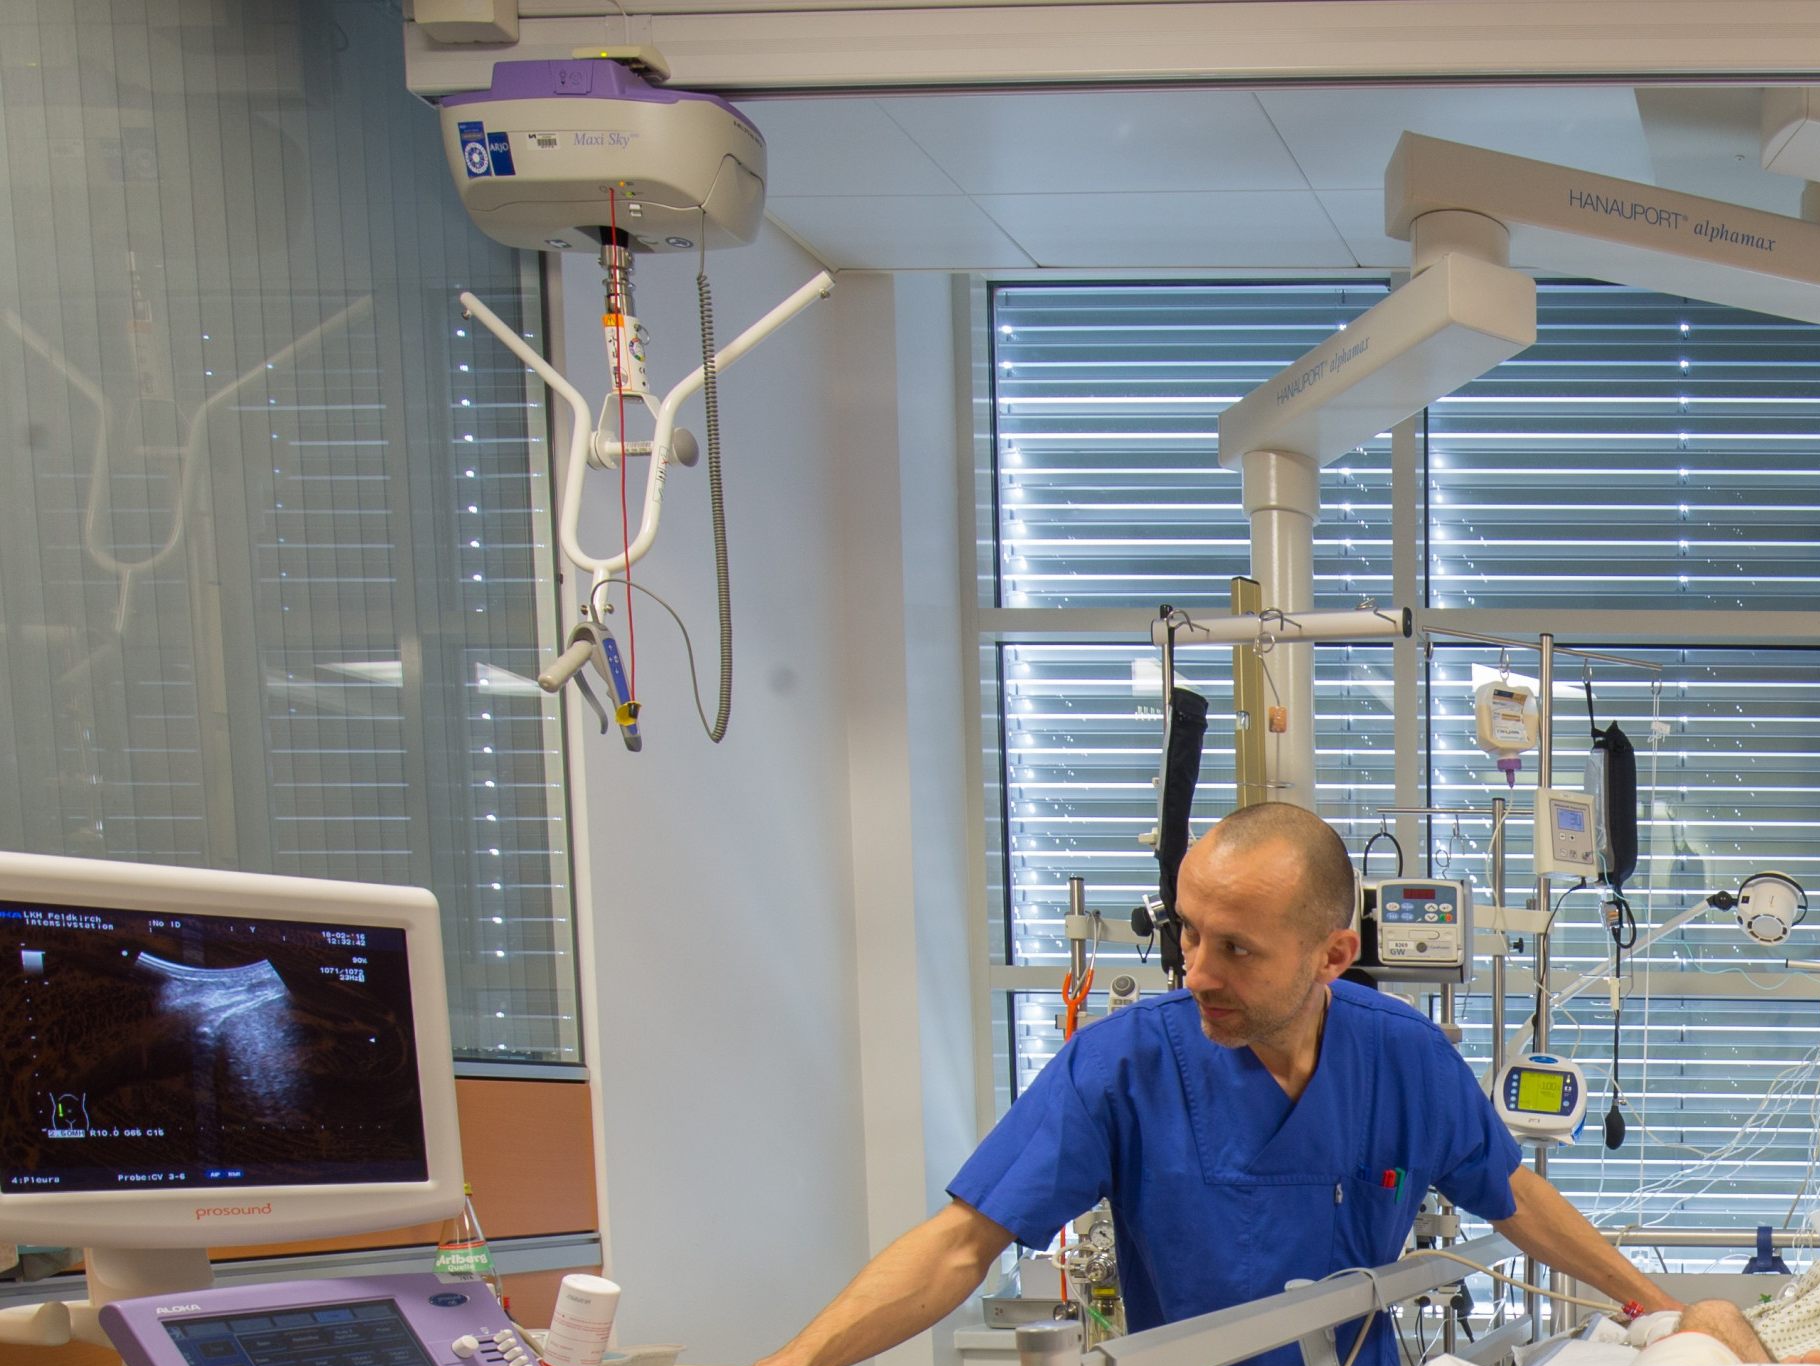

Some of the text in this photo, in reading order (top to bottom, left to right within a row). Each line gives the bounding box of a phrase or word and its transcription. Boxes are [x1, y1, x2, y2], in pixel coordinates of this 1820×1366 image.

[489, 143, 509, 152] ARJO
[573, 132, 603, 146] Maxi
[608, 132, 631, 149] Sky
[1569, 189, 1776, 251] HANAUPORT alphamax
[1277, 337, 1370, 406] HANAUPORT alphamax
[23, 911, 102, 923] LKH Feldkirch
[25, 918, 114, 931] Intensivstation
[195, 1203, 272, 1220] prosound
[156, 1303, 201, 1315] ALOKA
